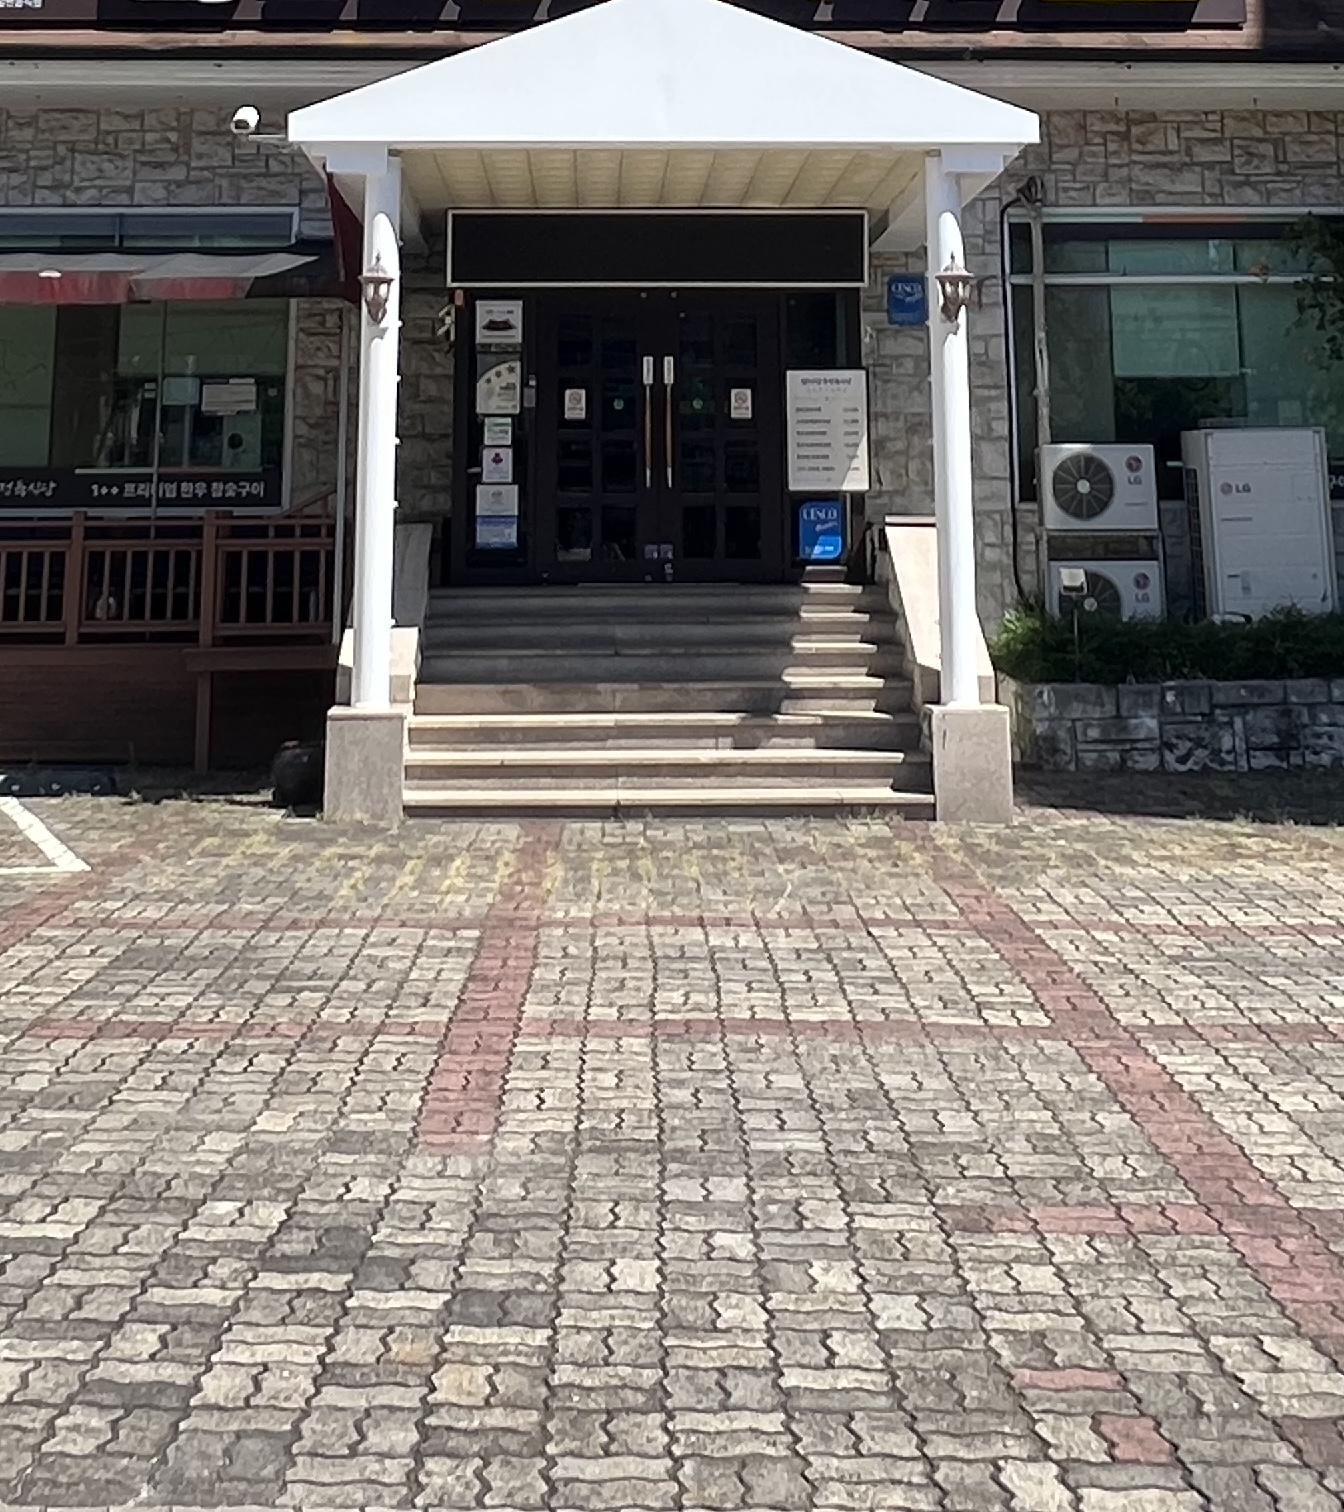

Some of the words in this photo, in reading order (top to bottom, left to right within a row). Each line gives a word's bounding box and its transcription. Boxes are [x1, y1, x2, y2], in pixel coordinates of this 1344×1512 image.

[1128, 475, 1142, 485] LG
[1235, 483, 1252, 493] LG
[1135, 592, 1150, 603] LG
